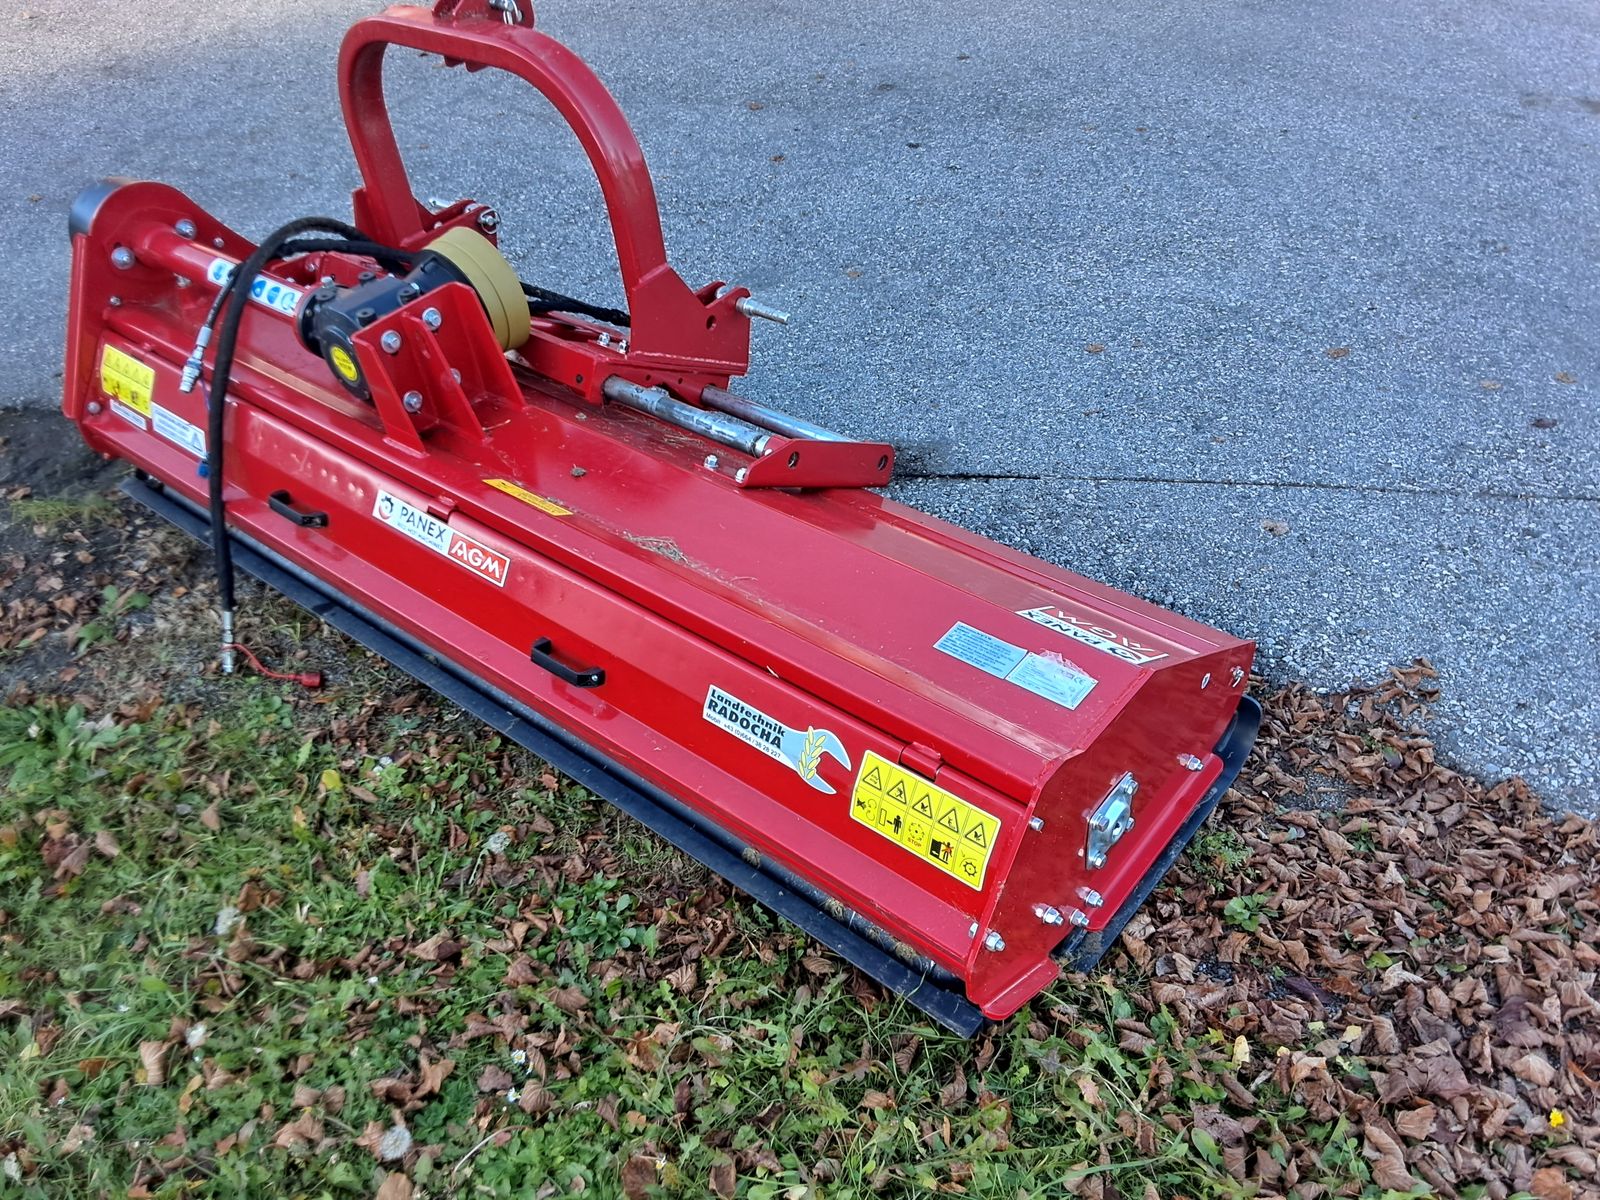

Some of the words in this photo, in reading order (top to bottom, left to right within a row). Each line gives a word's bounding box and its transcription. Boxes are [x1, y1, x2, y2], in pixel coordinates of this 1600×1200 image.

[400, 507, 447, 543] PANEX
[451, 540, 500, 578] AGM
[1021, 610, 1103, 646] PANEX
[1057, 610, 1156, 652] AGM
[707, 699, 782, 750] RADOCHA
[711, 689, 786, 737] Landtechnik
[907, 837, 922, 847] STOP
